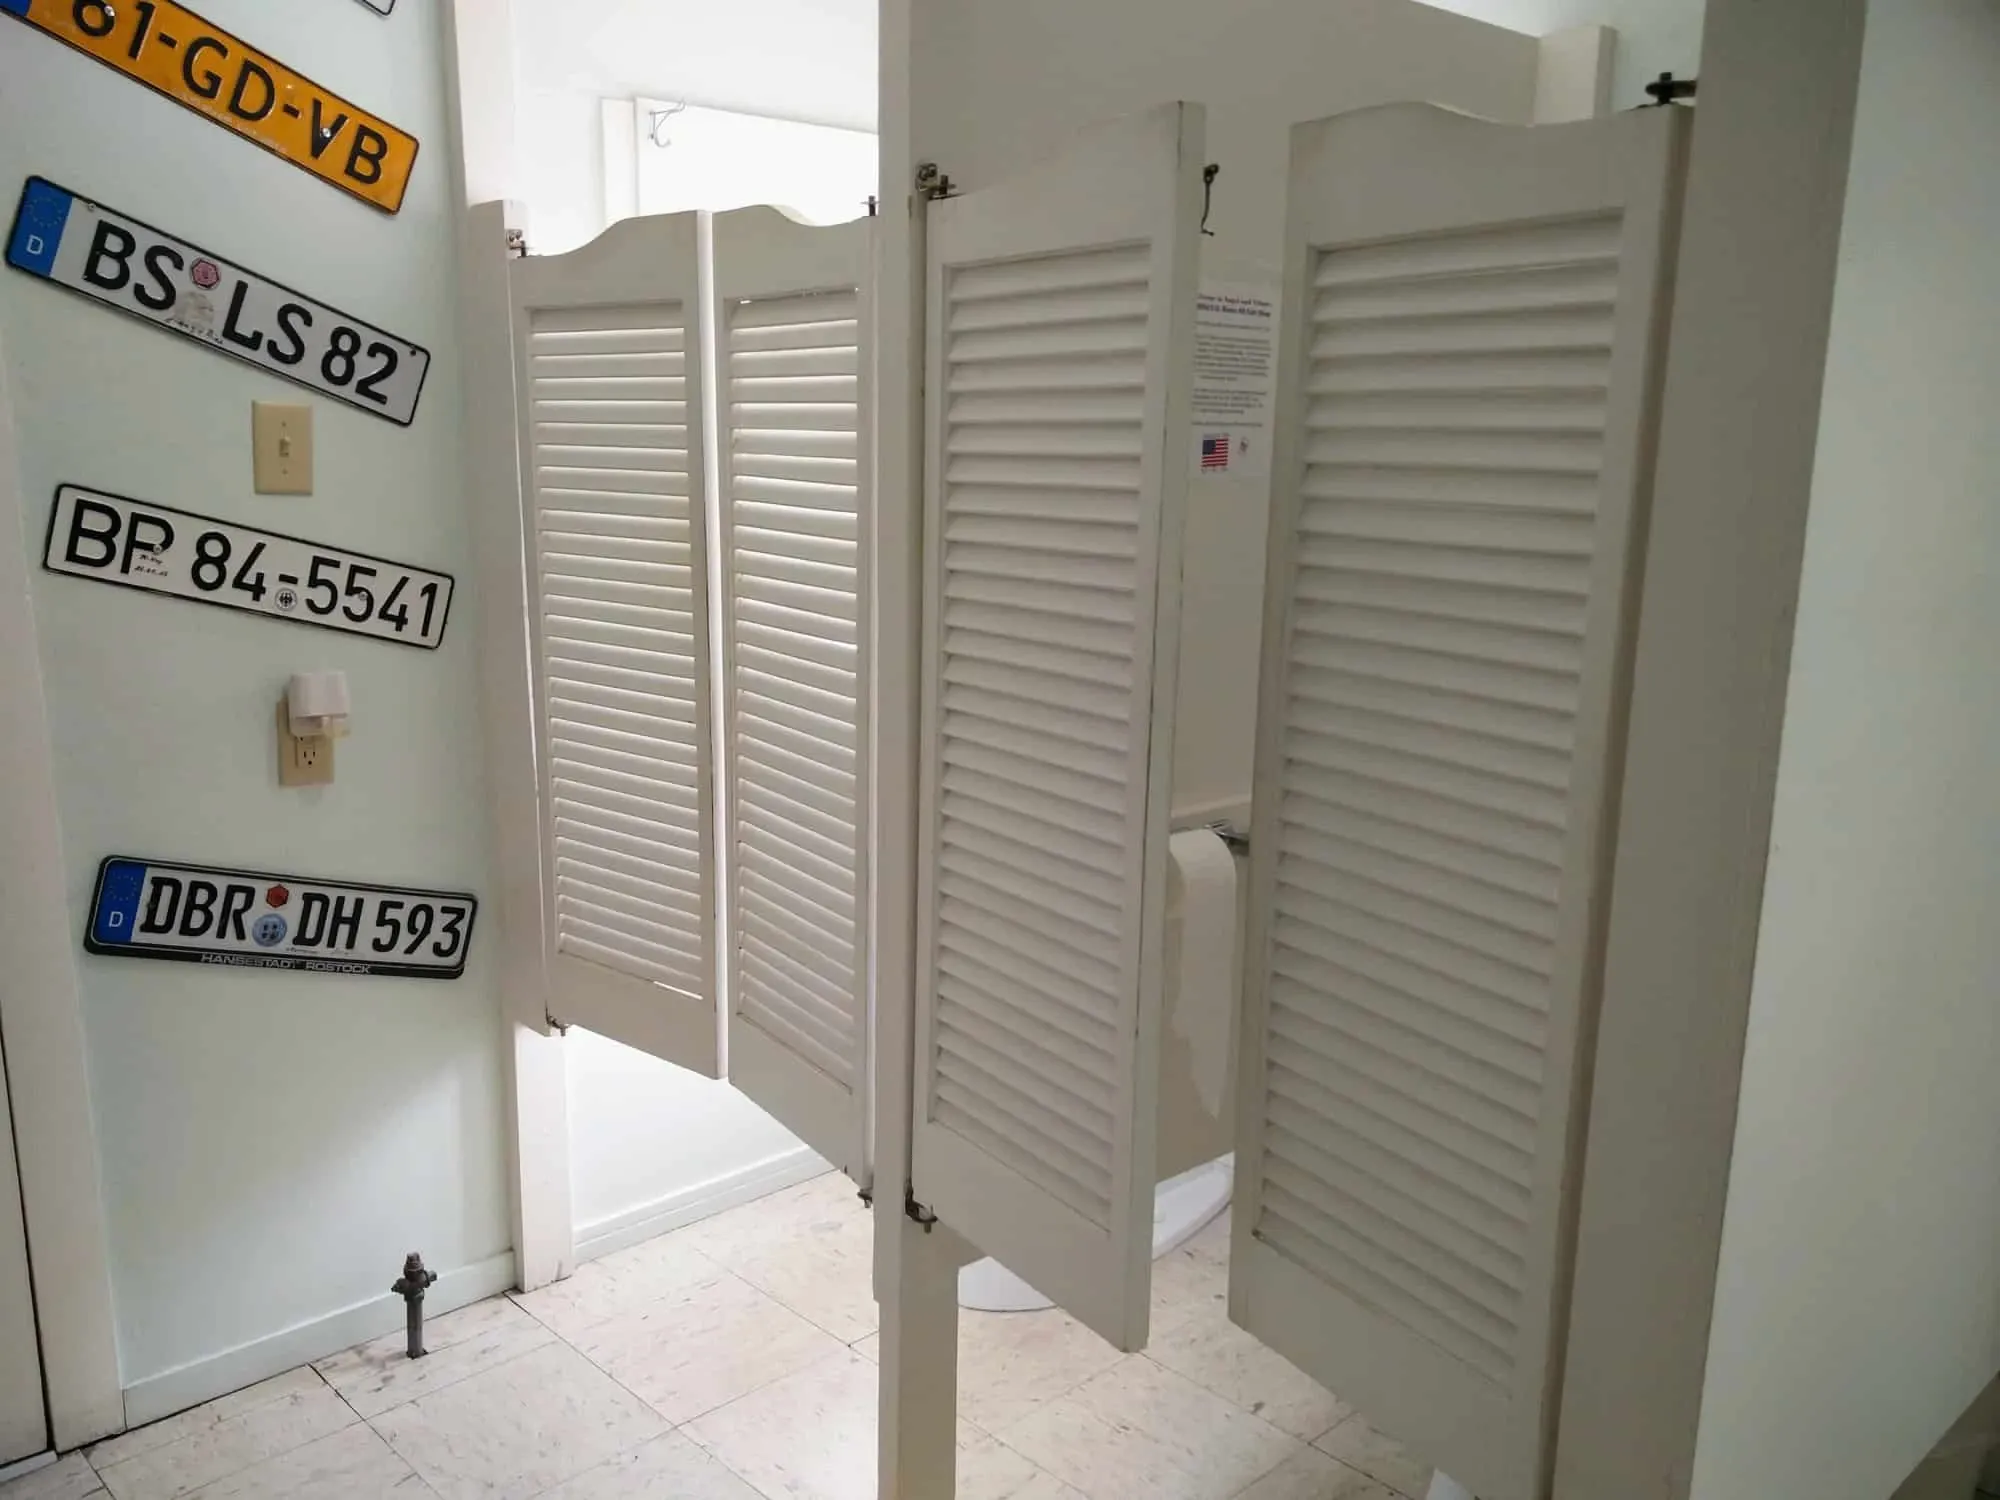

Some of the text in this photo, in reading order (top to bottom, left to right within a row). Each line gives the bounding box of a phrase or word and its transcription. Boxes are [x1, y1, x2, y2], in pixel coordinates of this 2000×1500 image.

[26, 234, 44, 256] D
[83, 219, 399, 405] BS LS 82
[64, 497, 440, 637] BP 84-5541
[108, 910, 124, 928] D
[139, 876, 466, 958] DBR DH 593
[305, 960, 372, 974] ROSTOCK
